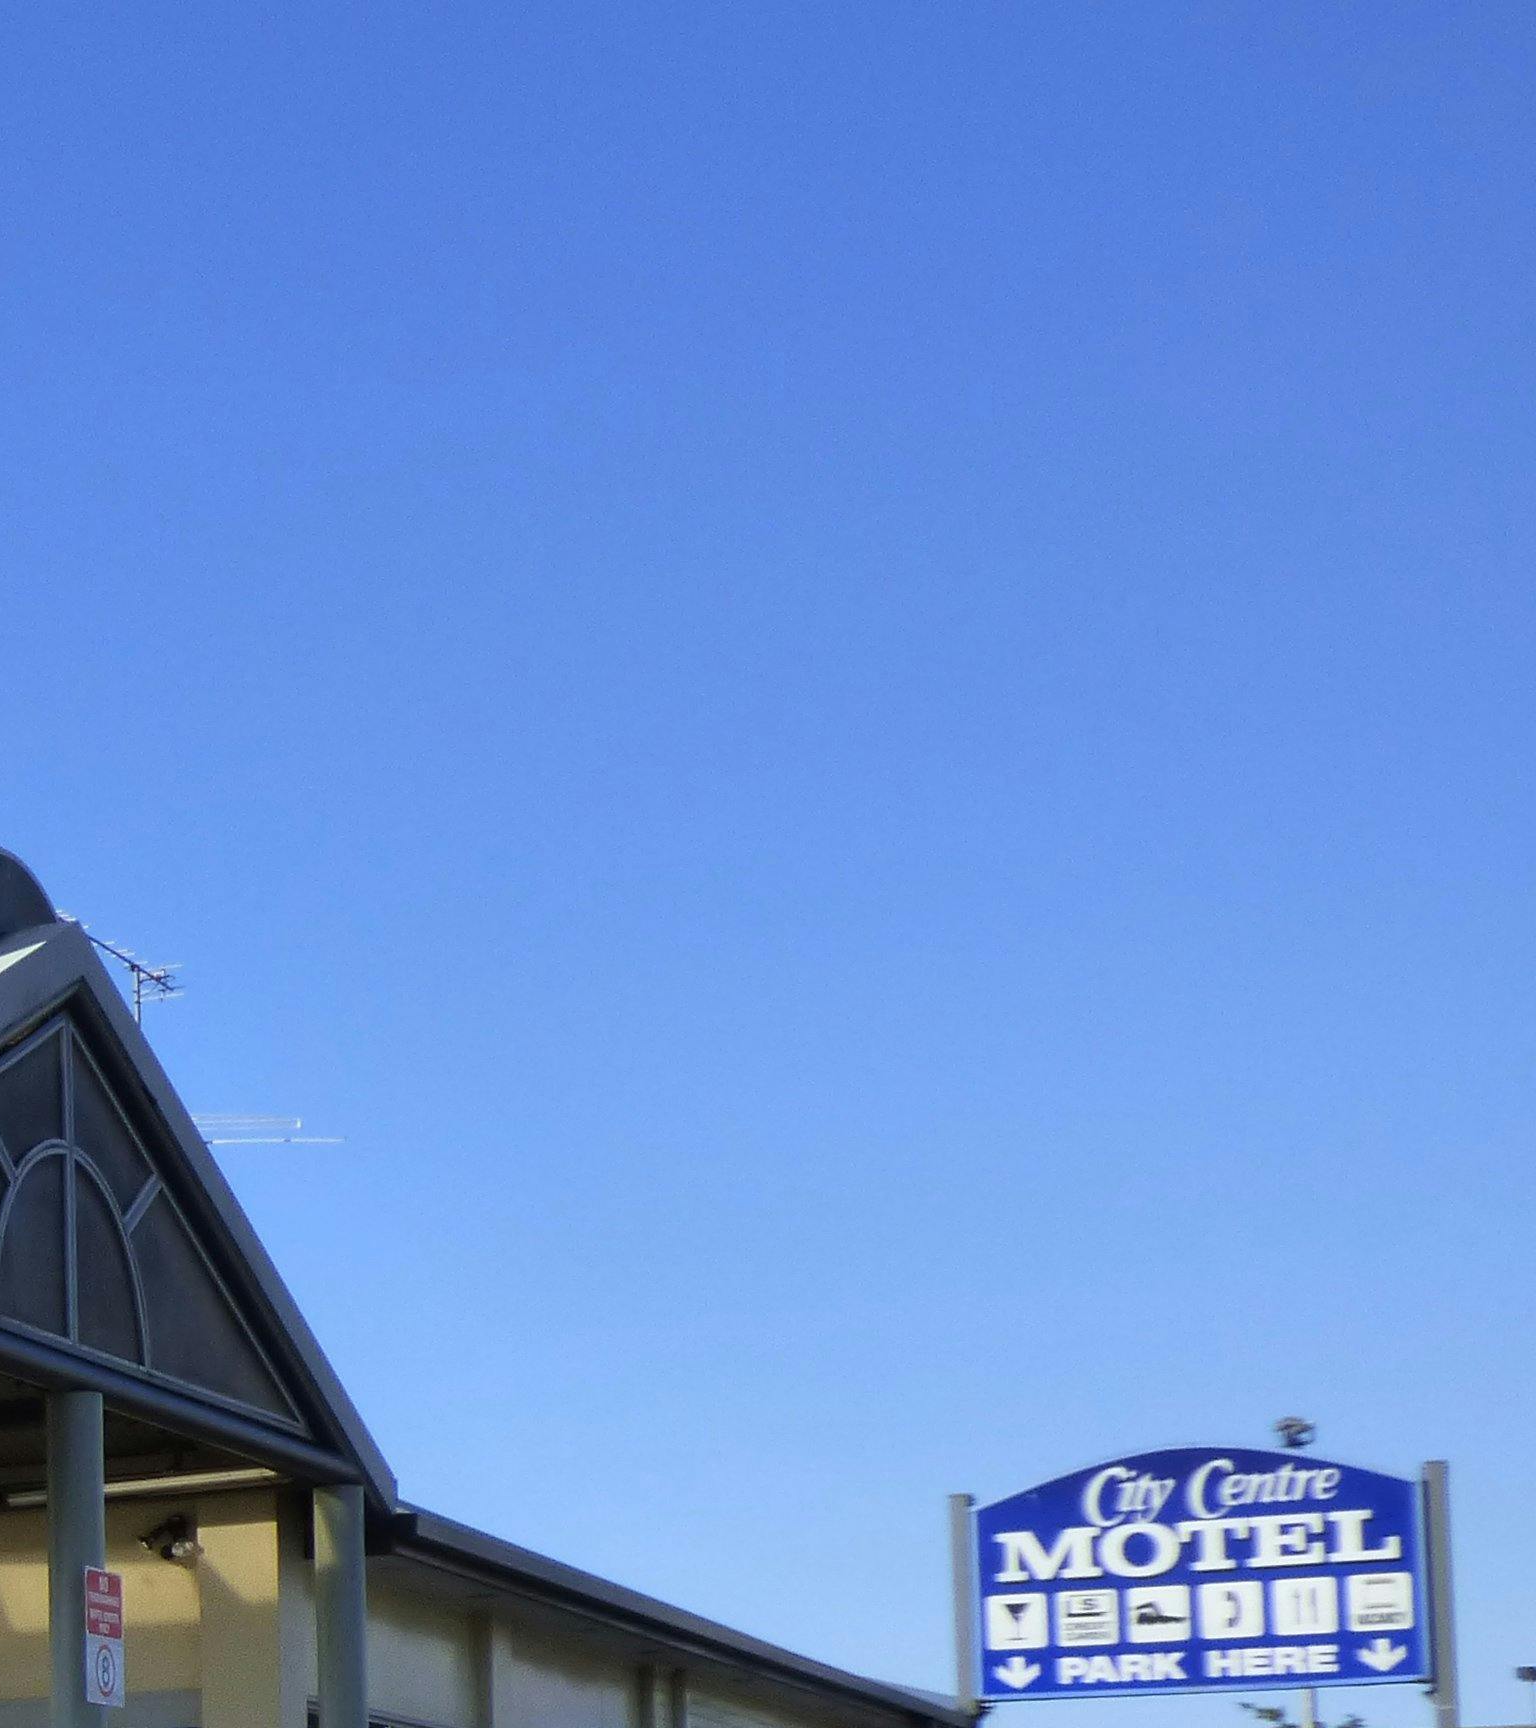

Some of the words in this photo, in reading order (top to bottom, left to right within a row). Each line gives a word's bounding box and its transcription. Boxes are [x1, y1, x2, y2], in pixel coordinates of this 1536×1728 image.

[1082, 1466, 1176, 1526] City
[1186, 1458, 1342, 1520] Centre
[993, 1508, 1403, 1584] MOTEL
[1056, 1650, 1188, 1686] PARK
[1204, 1643, 1342, 1679] HERE
